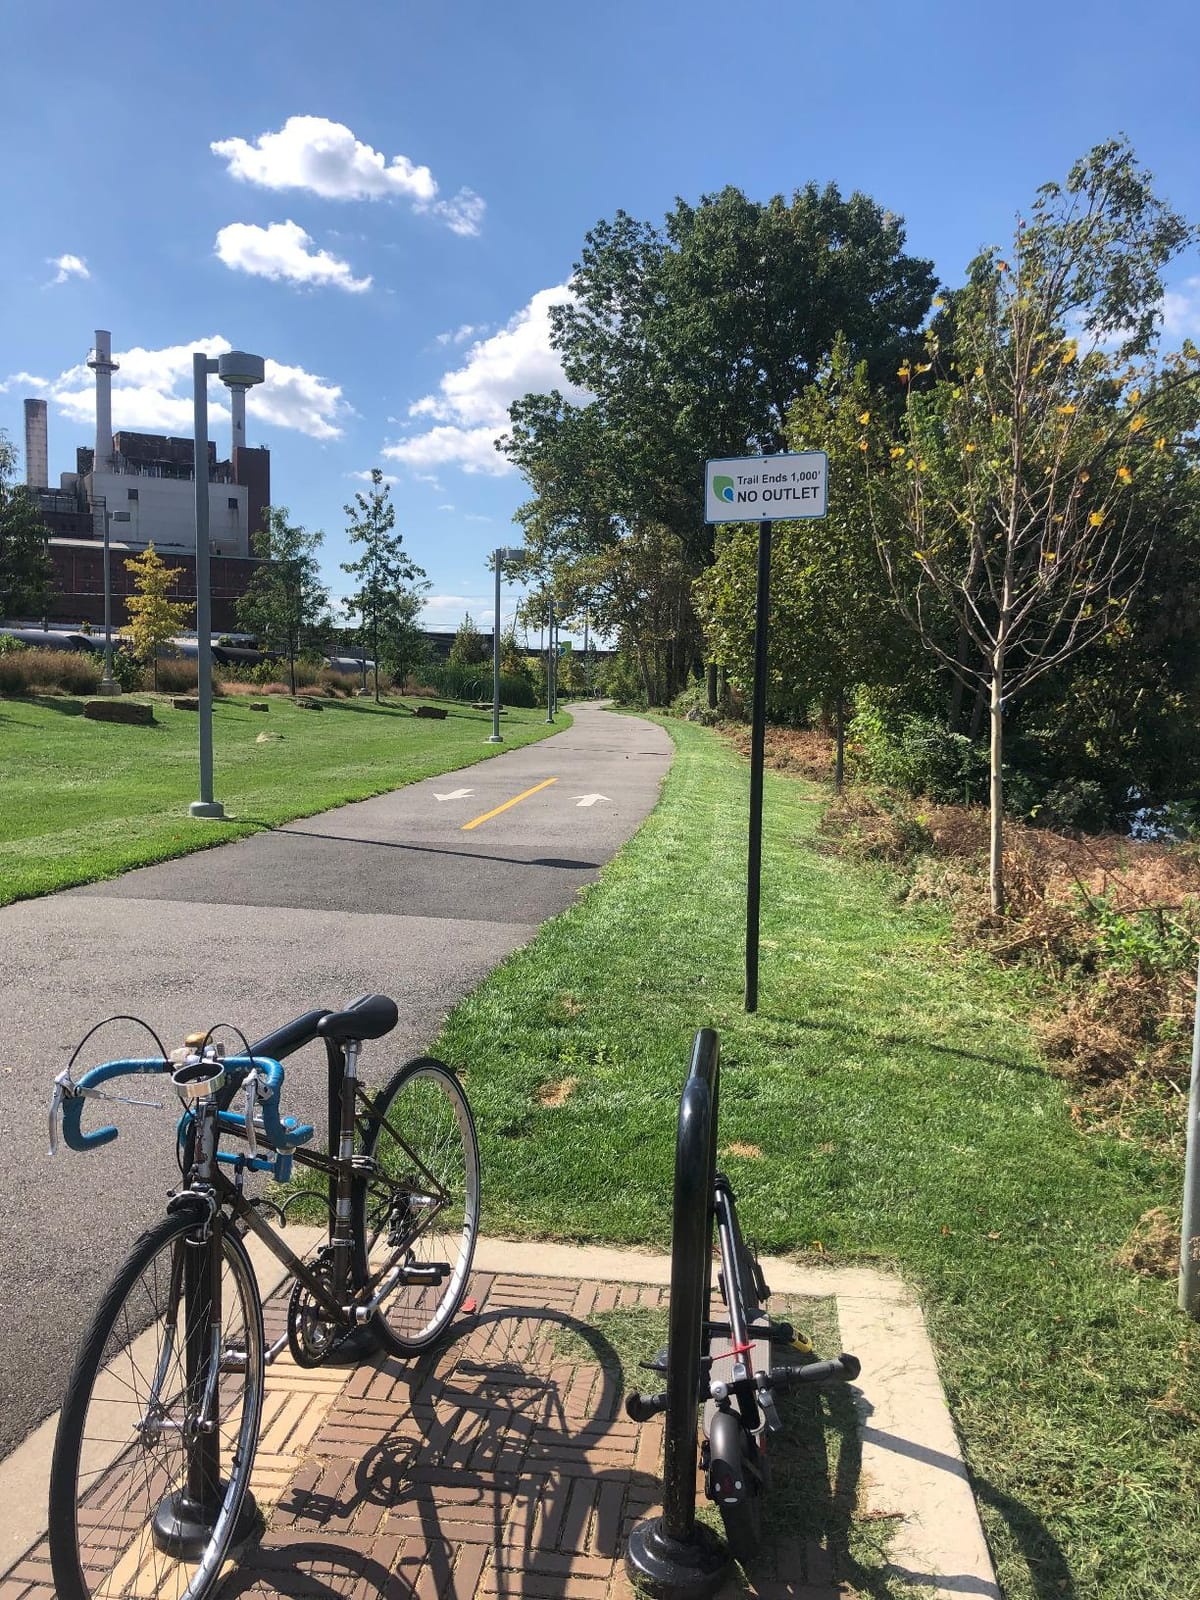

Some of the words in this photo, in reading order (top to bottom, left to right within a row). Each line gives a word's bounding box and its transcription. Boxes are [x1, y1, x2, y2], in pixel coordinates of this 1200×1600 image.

[737, 475, 759, 485] Trail
[762, 473, 788, 484] Ends
[737, 490, 758, 503] NO
[762, 486, 820, 502] OUTLET
